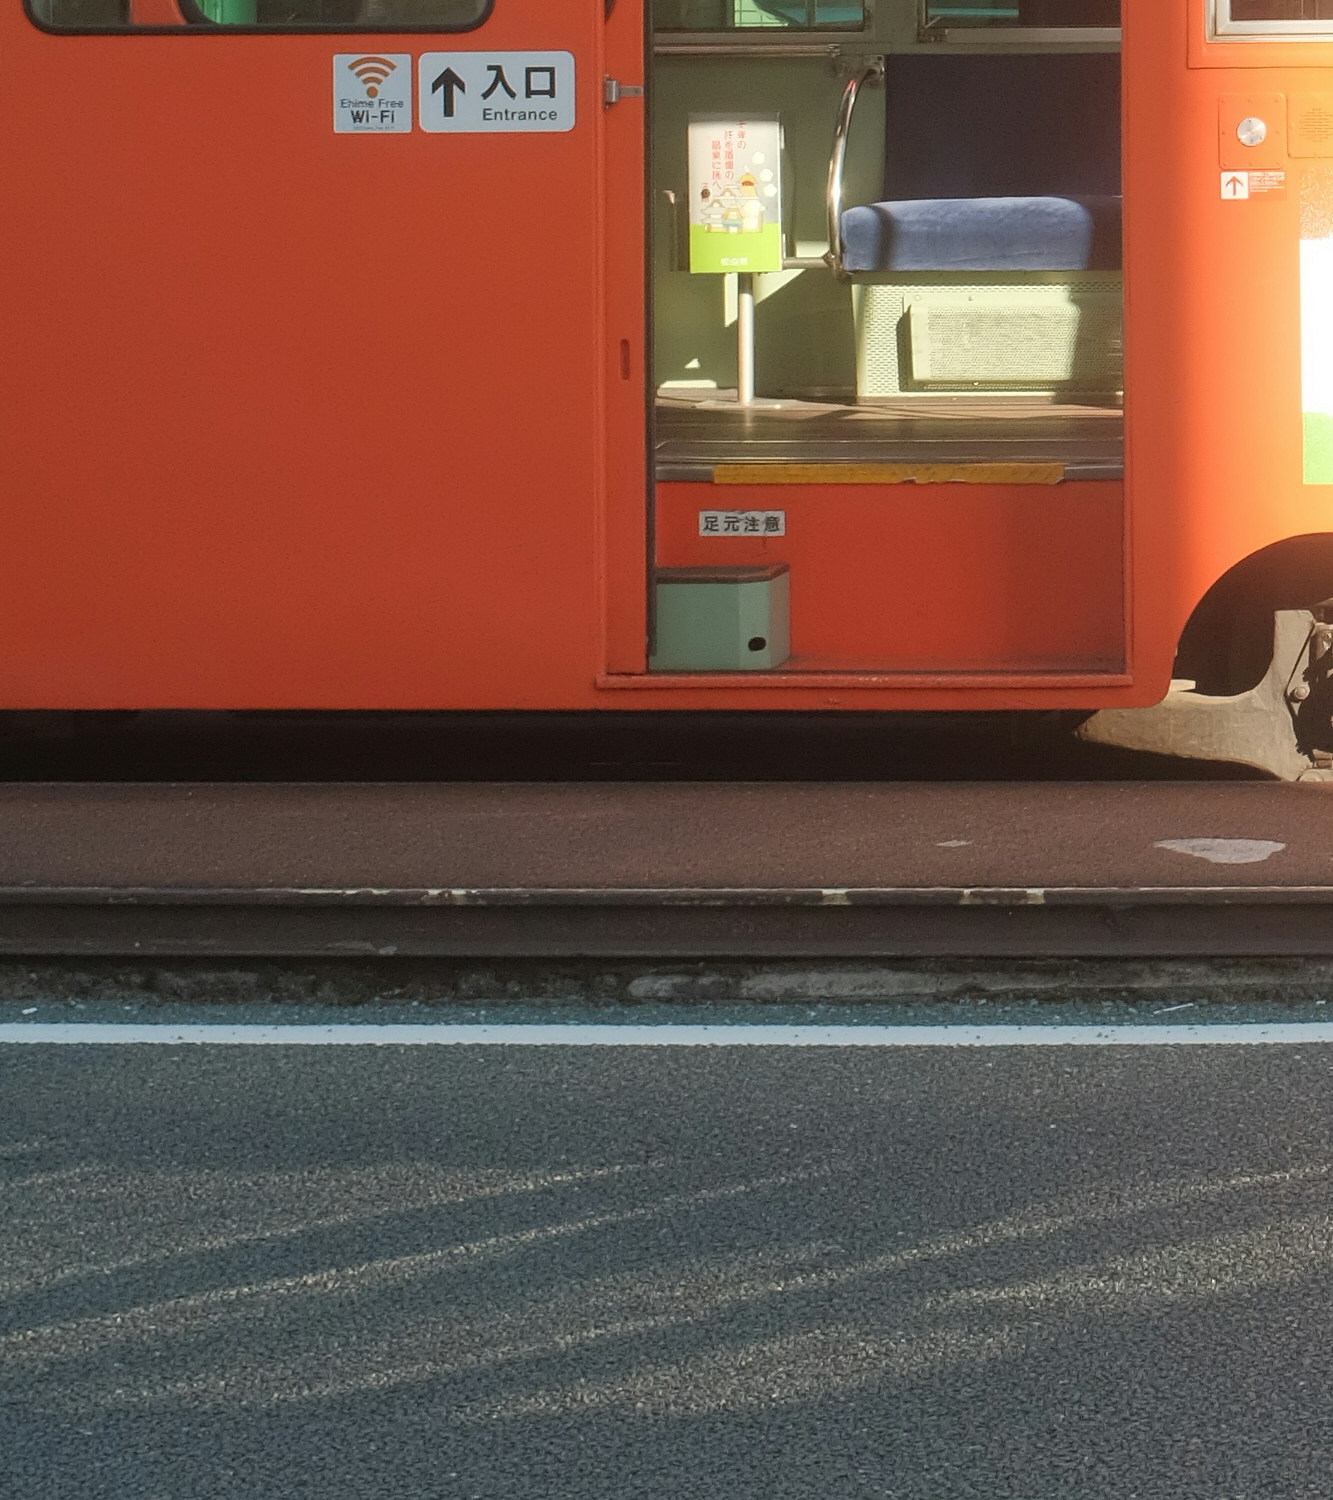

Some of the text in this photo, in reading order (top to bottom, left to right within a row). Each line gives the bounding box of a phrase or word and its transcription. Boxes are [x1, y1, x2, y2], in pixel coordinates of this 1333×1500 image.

[481, 64, 555, 100] 入口
[379, 98, 404, 108] Free
[351, 110, 395, 124] Wi-Fi
[482, 108, 558, 121] Entrance
[703, 515, 780, 532] 足元注意
